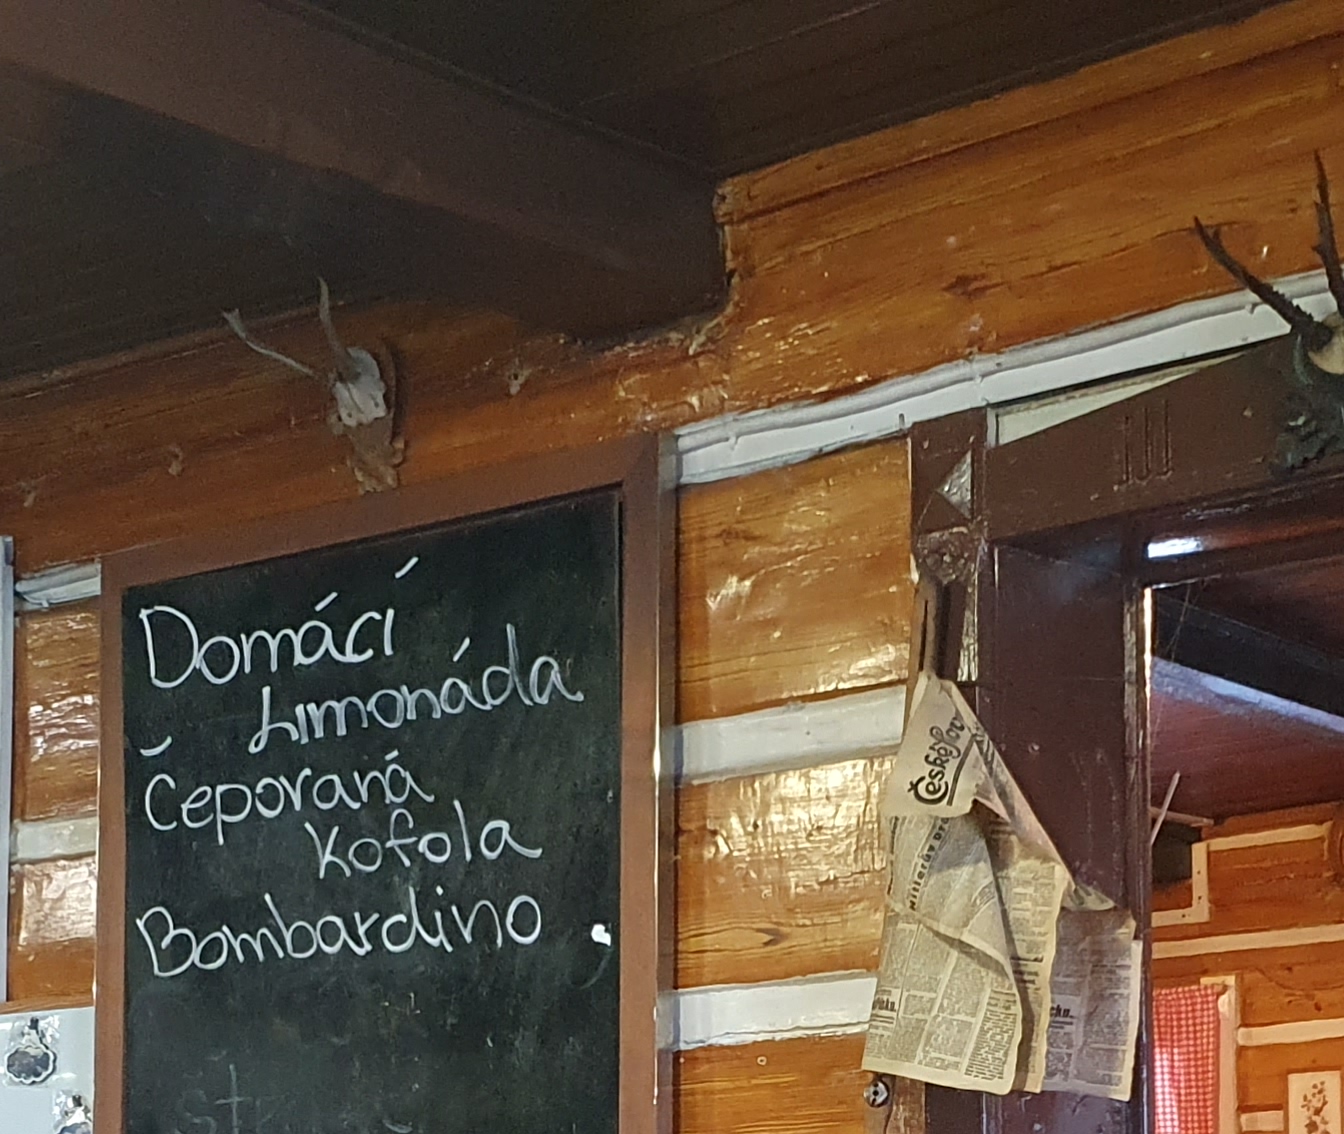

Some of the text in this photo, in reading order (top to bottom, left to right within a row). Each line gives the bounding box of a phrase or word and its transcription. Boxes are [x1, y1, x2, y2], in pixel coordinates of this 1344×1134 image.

[139, 556, 419, 689] Domácí
[248, 622, 584, 755] Limonáda
[137, 885, 542, 978] Bombardino
